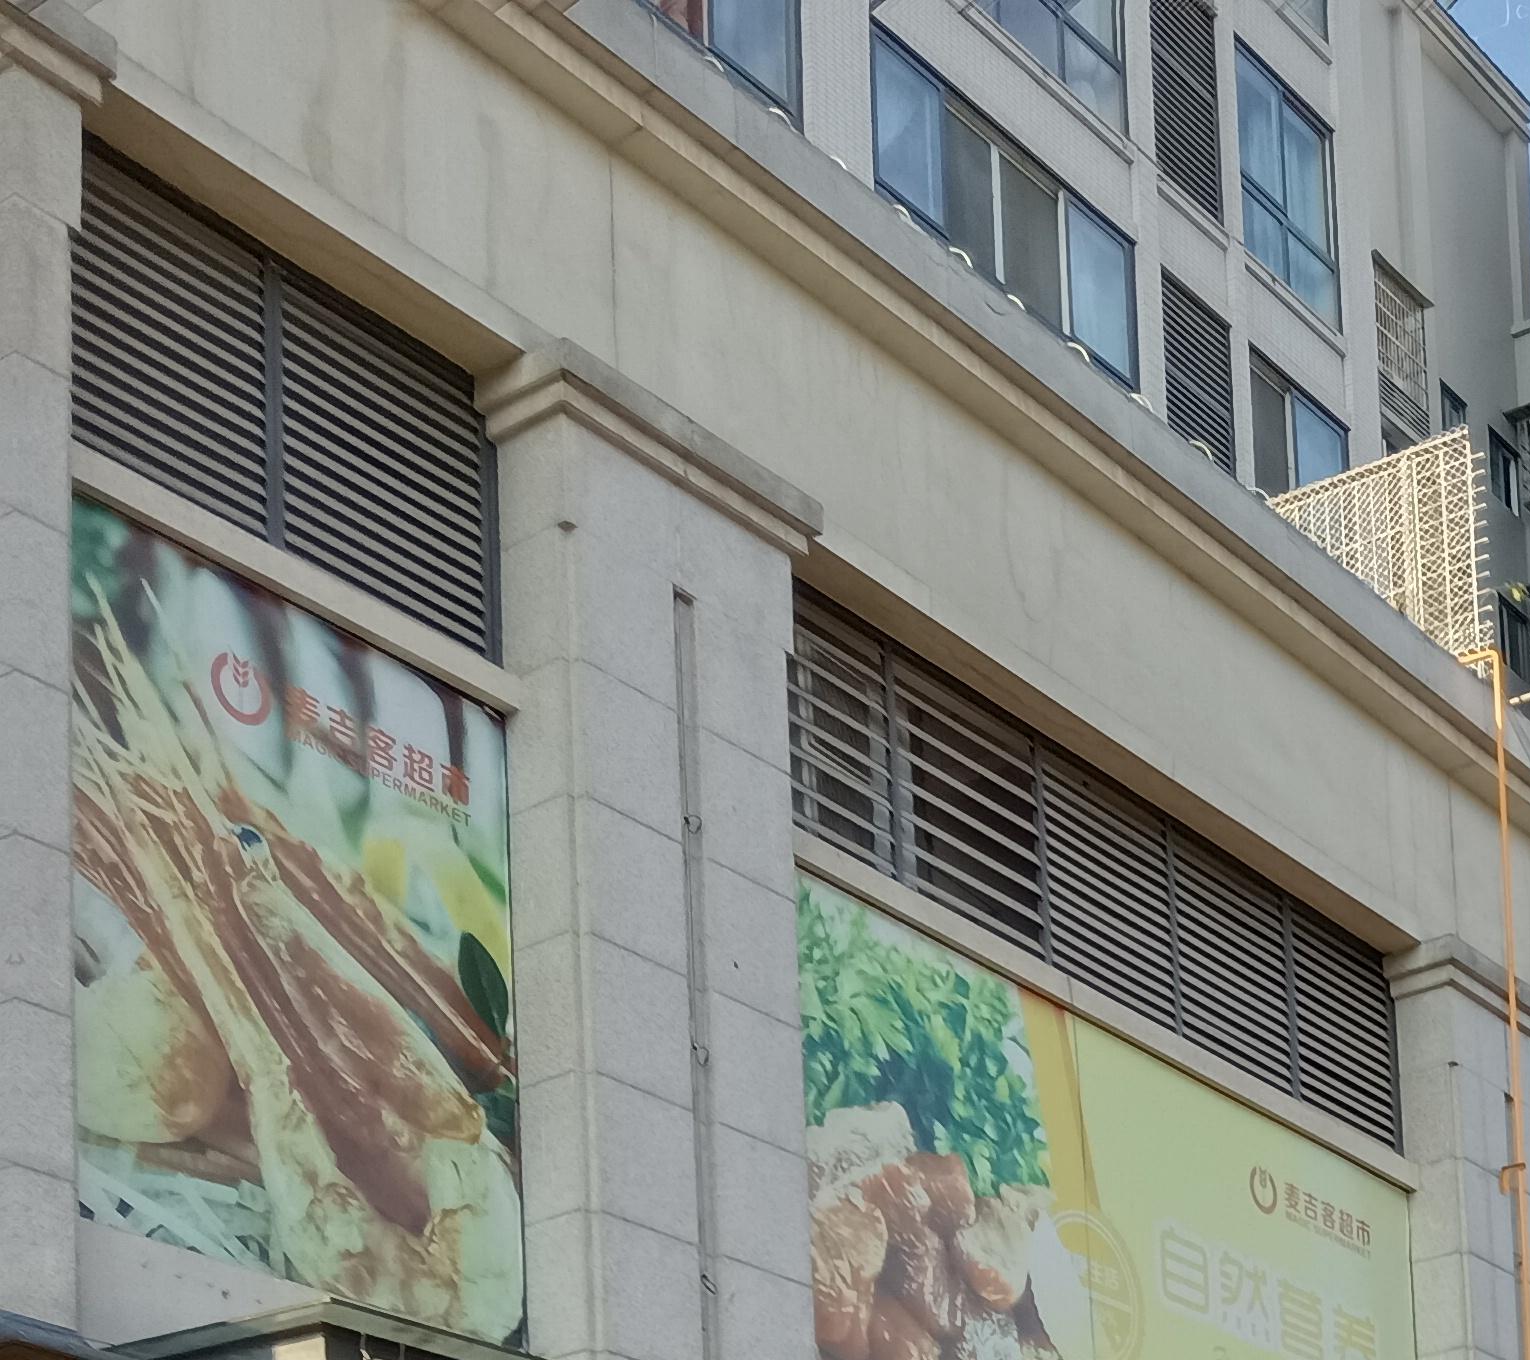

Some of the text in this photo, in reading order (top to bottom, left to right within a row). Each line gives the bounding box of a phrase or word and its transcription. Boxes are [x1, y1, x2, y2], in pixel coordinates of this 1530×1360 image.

[1283, 1182, 1372, 1249] 麦吉客超市
